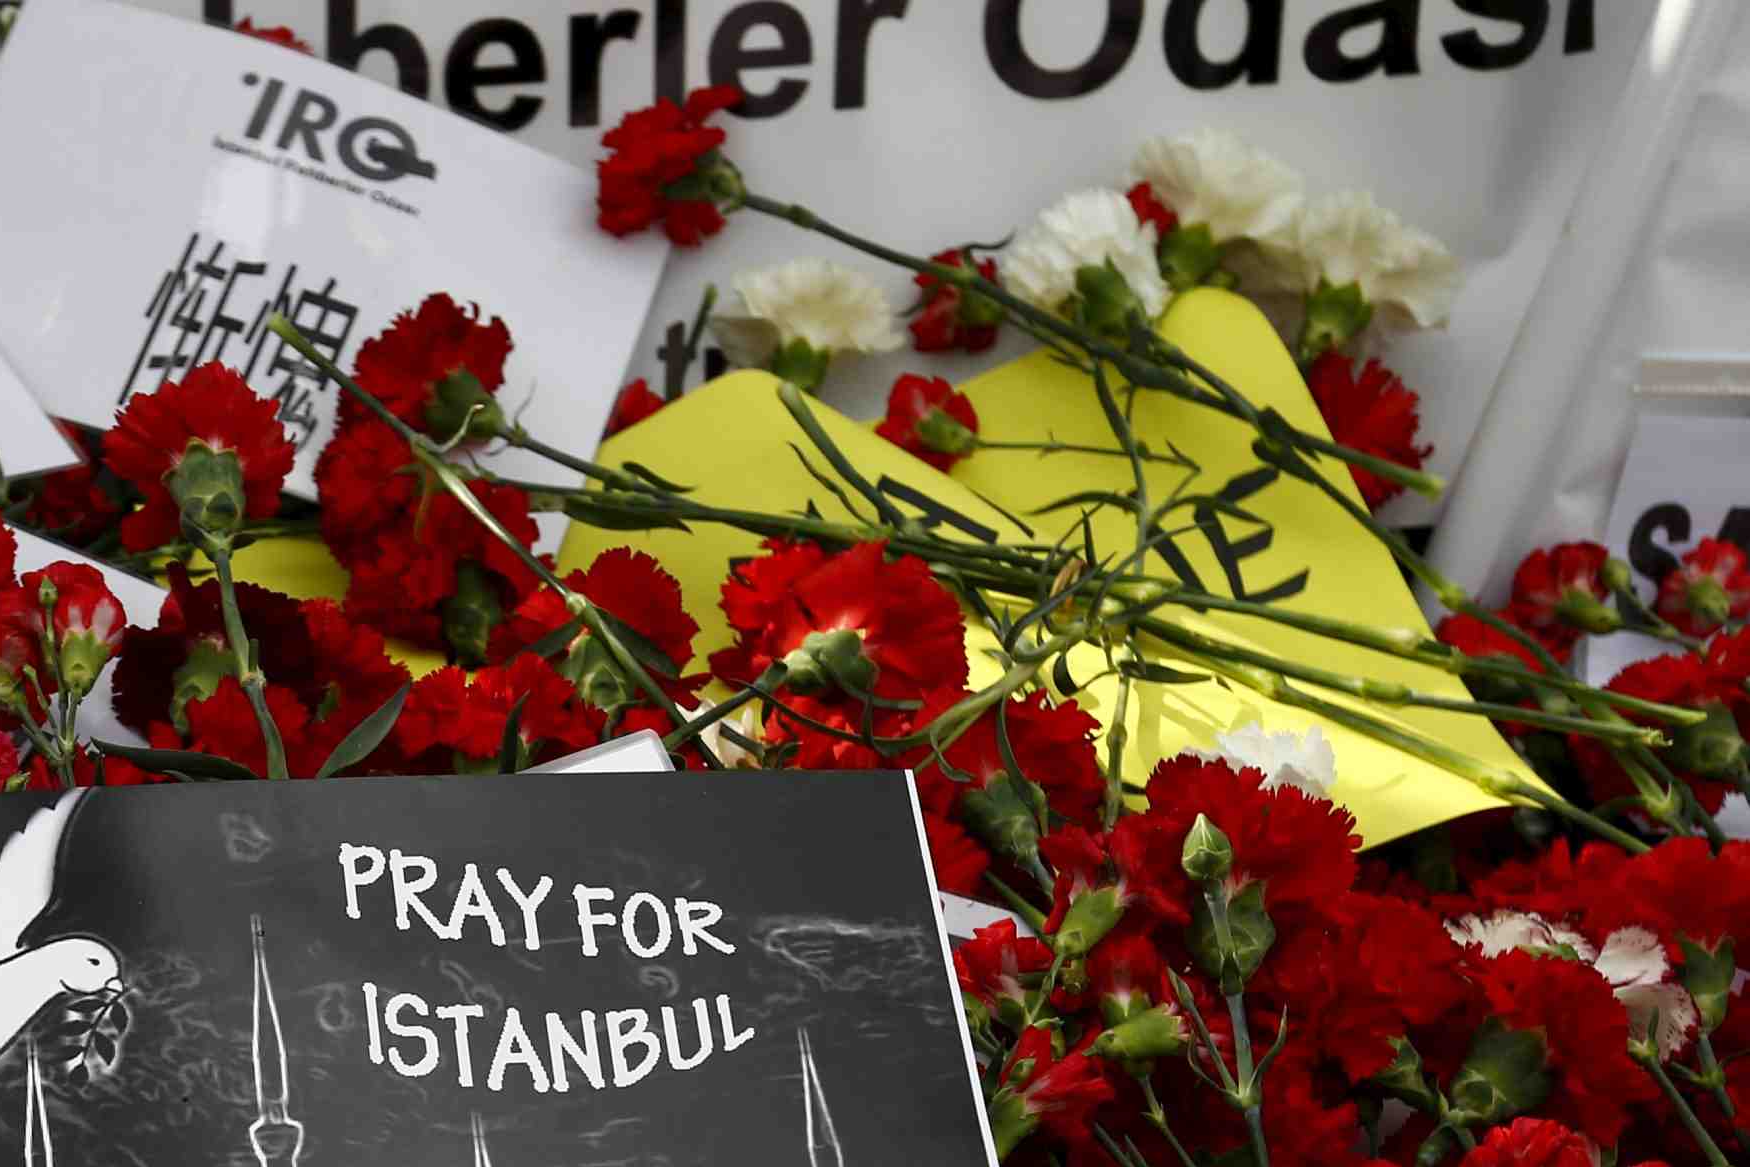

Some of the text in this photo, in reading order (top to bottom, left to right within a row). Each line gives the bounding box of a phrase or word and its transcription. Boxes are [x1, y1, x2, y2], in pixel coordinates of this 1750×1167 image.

[338, 842, 737, 958] PRAY FOR
[361, 981, 755, 1093] ISTANBUL
